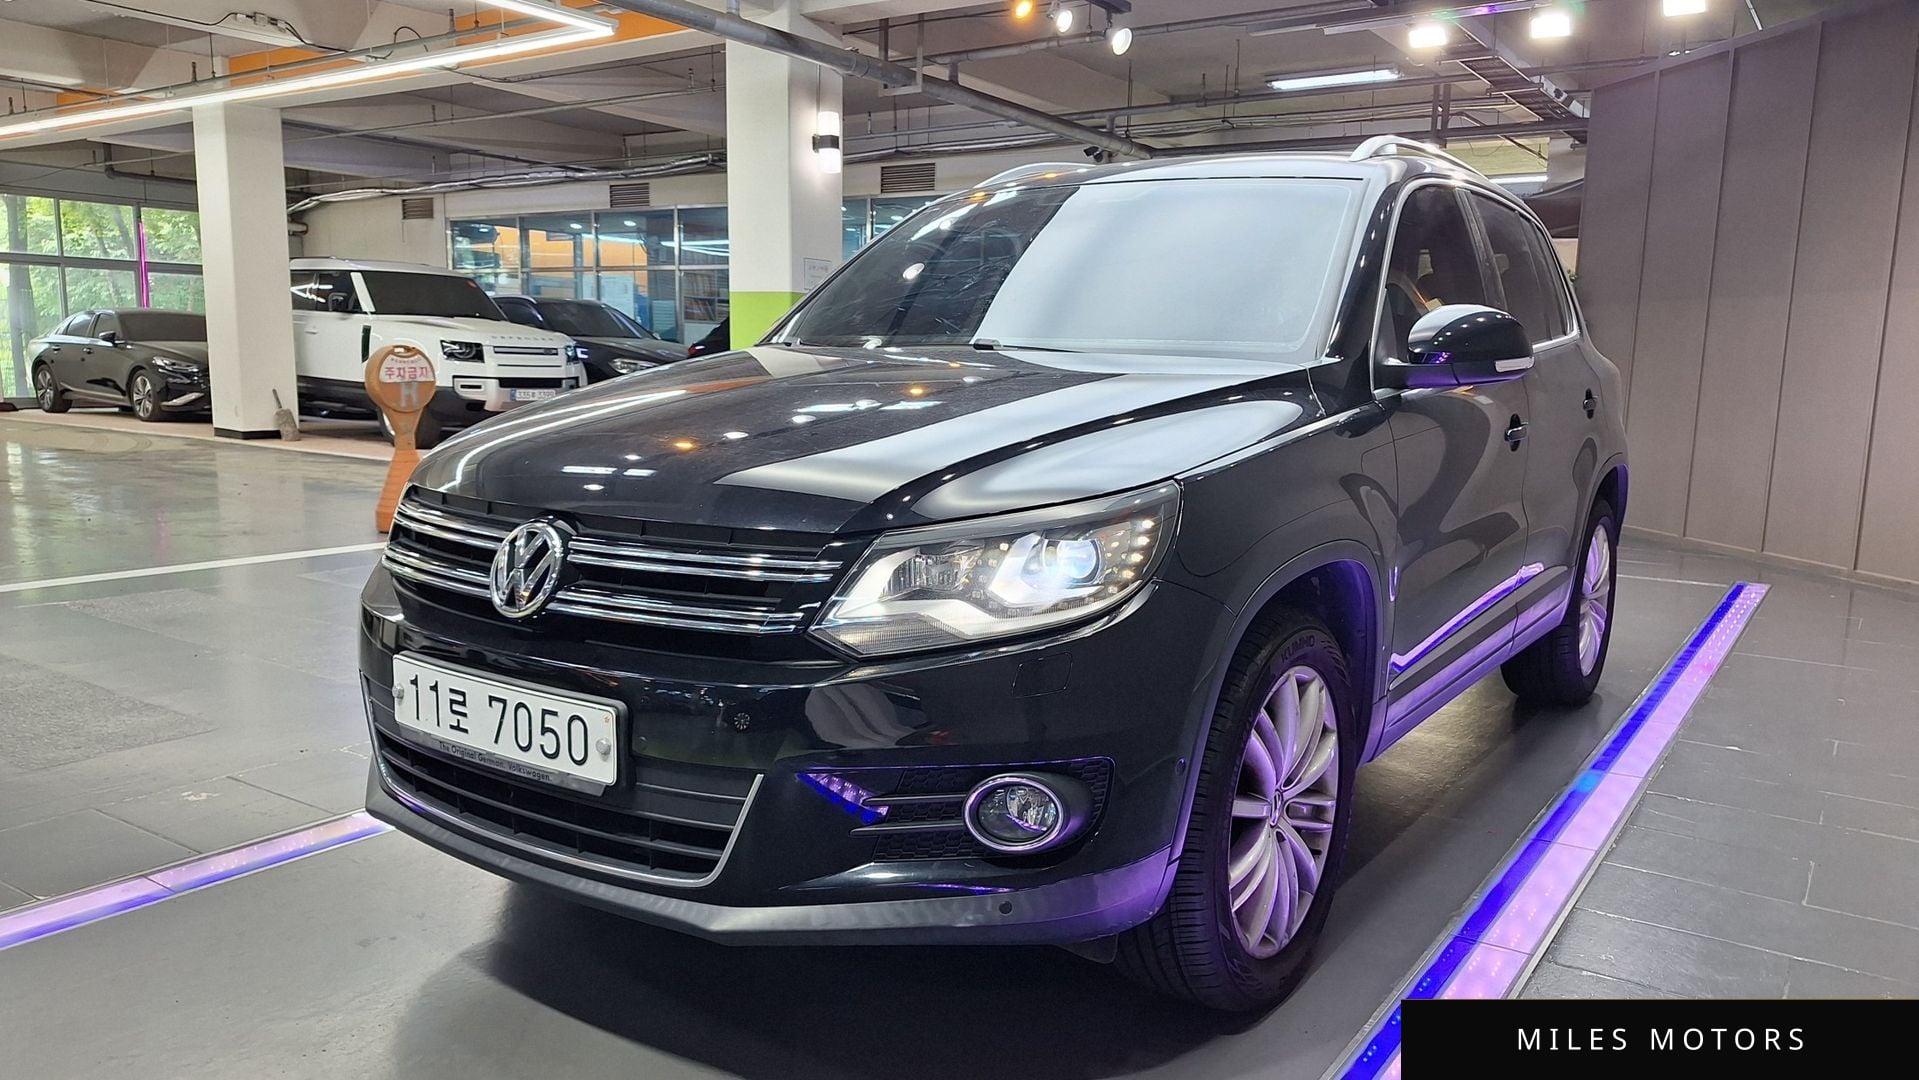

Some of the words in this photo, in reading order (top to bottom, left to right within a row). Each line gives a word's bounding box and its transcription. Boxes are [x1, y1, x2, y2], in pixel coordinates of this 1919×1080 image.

[409, 674, 469, 734] 11로
[488, 695, 589, 766] 7050
[439, 741, 450, 752] The
[451, 745, 477, 760] Original
